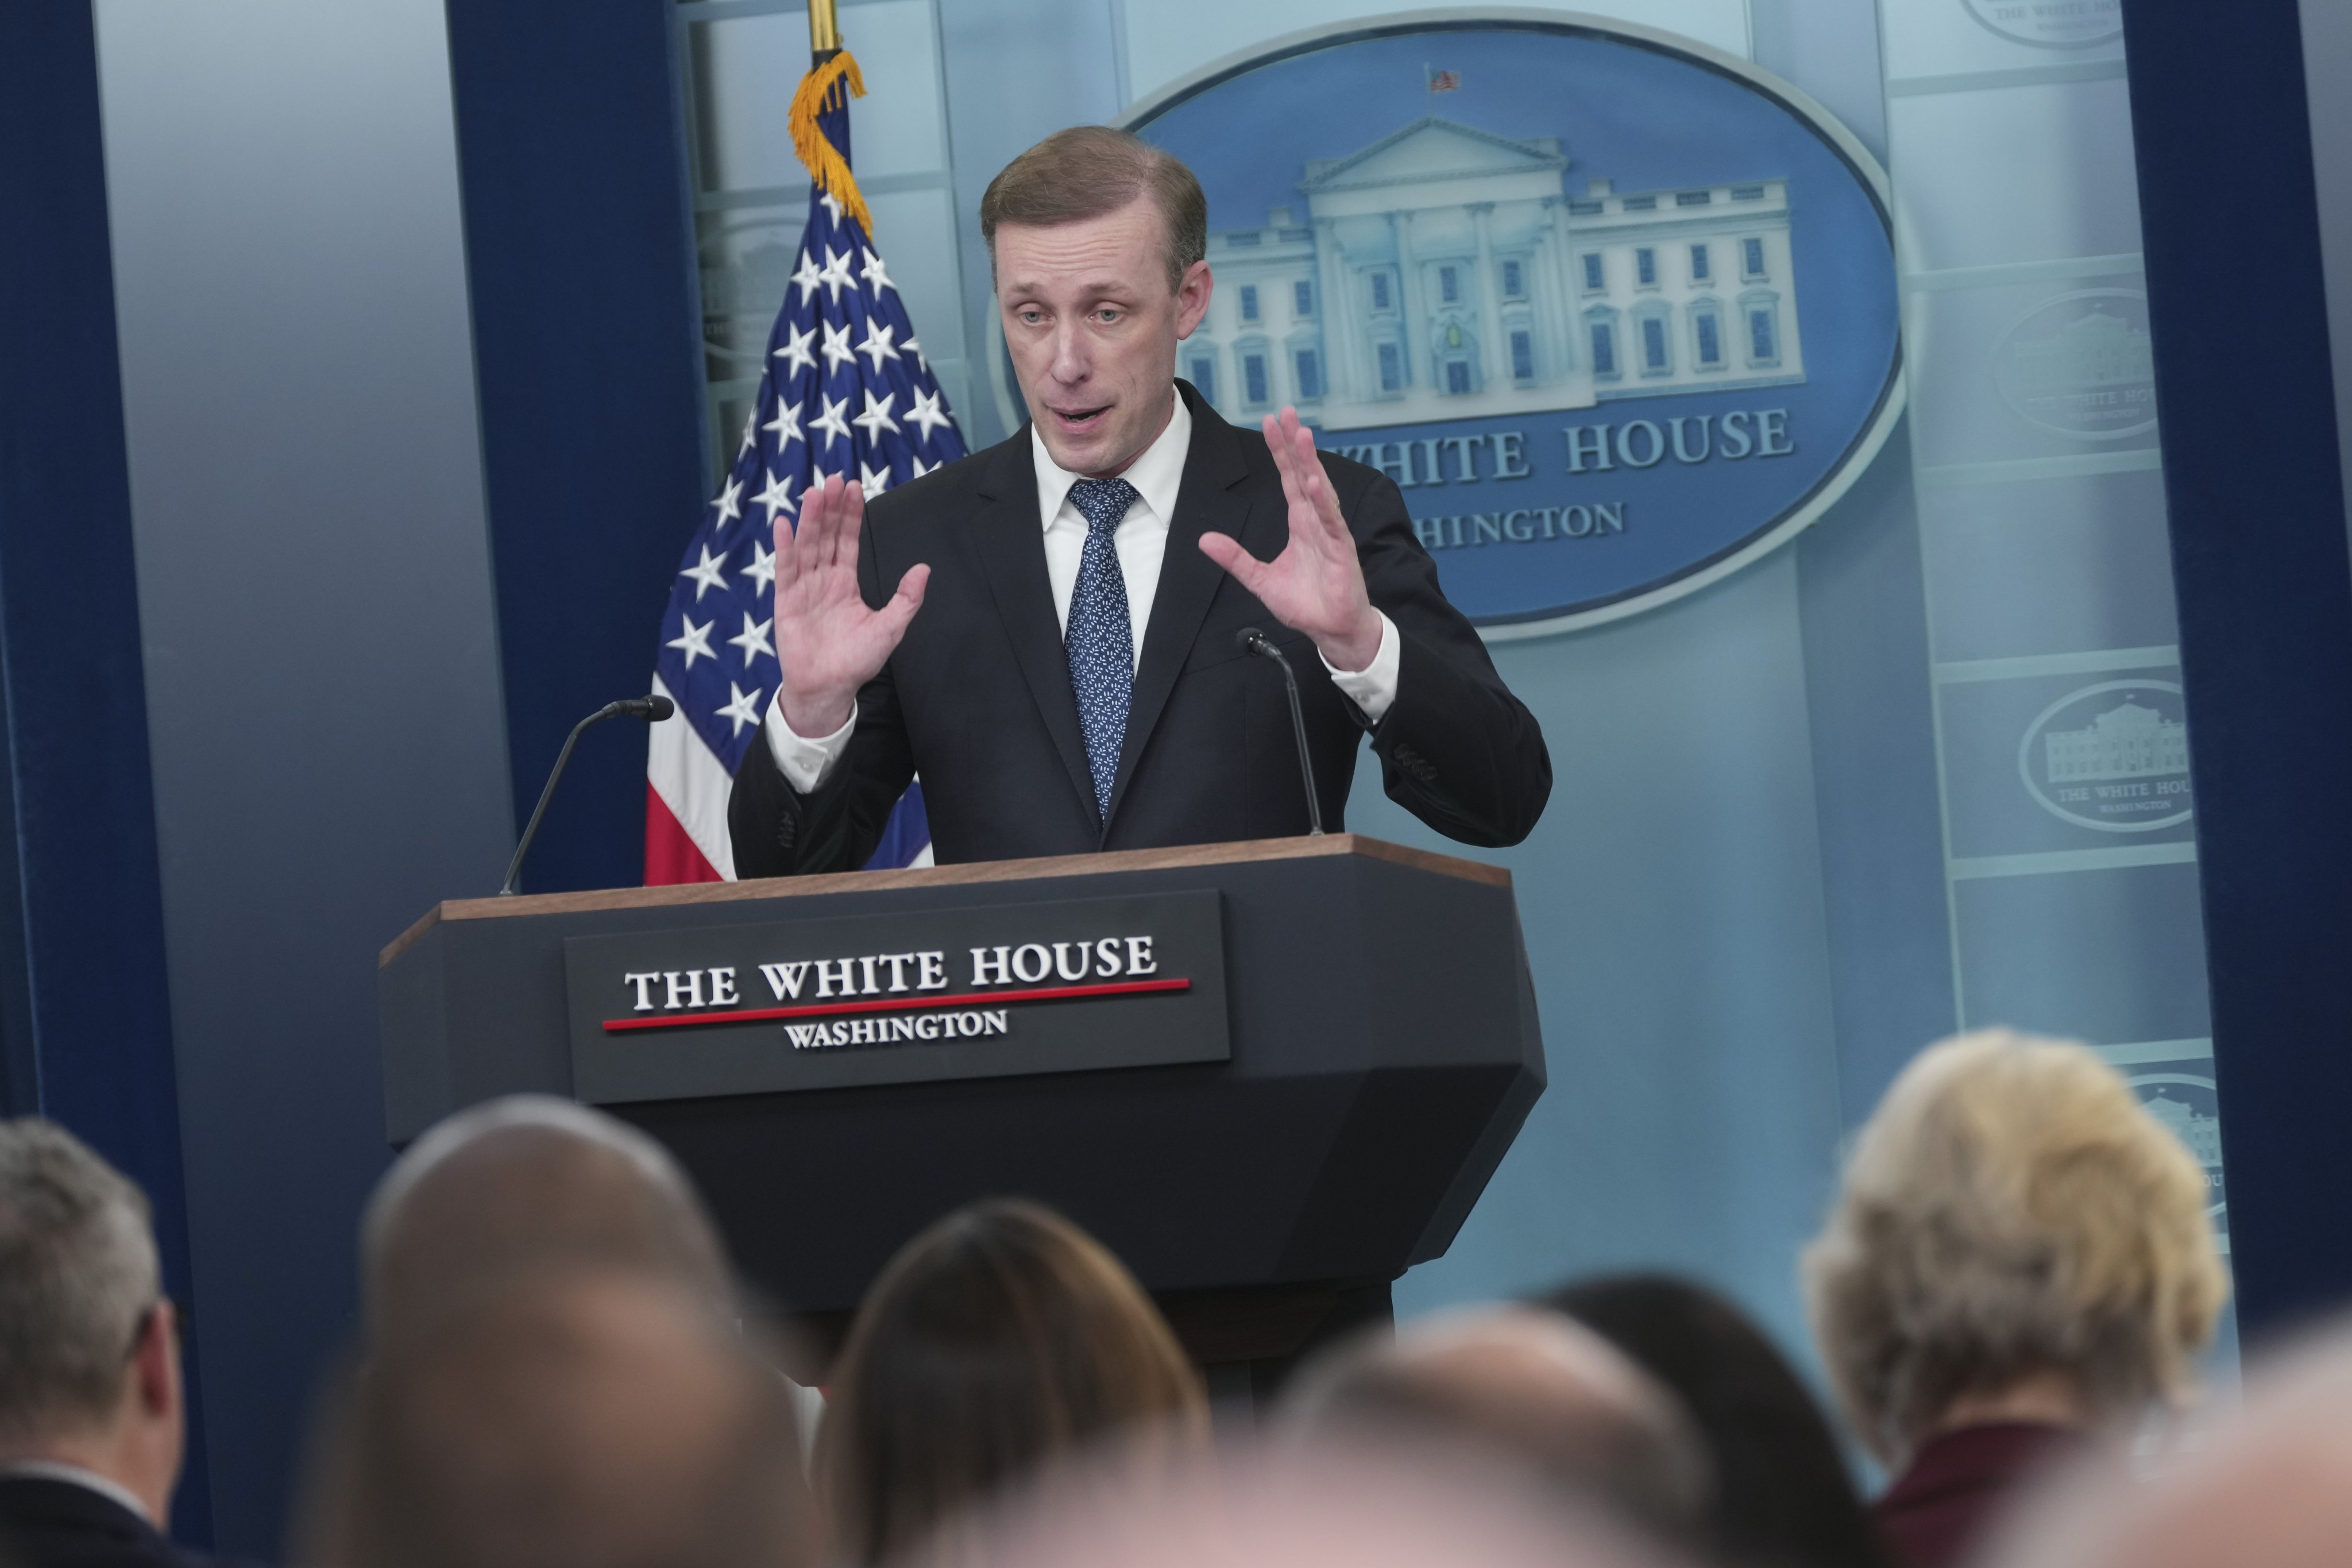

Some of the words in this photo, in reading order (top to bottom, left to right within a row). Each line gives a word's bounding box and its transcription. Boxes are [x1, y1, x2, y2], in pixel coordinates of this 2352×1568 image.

[1565, 408, 1794, 474] HOUSE
[1410, 501, 1626, 550] HINGTON
[2057, 787, 2090, 802] THE
[2094, 783, 2150, 798] WHITE
[2155, 779, 2191, 795] HOU
[625, 967, 740, 1012] THE
[758, 951, 948, 1001] WHITE
[969, 936, 1158, 987] HOUSE
[784, 1009, 1009, 1050] WASHINGTON
